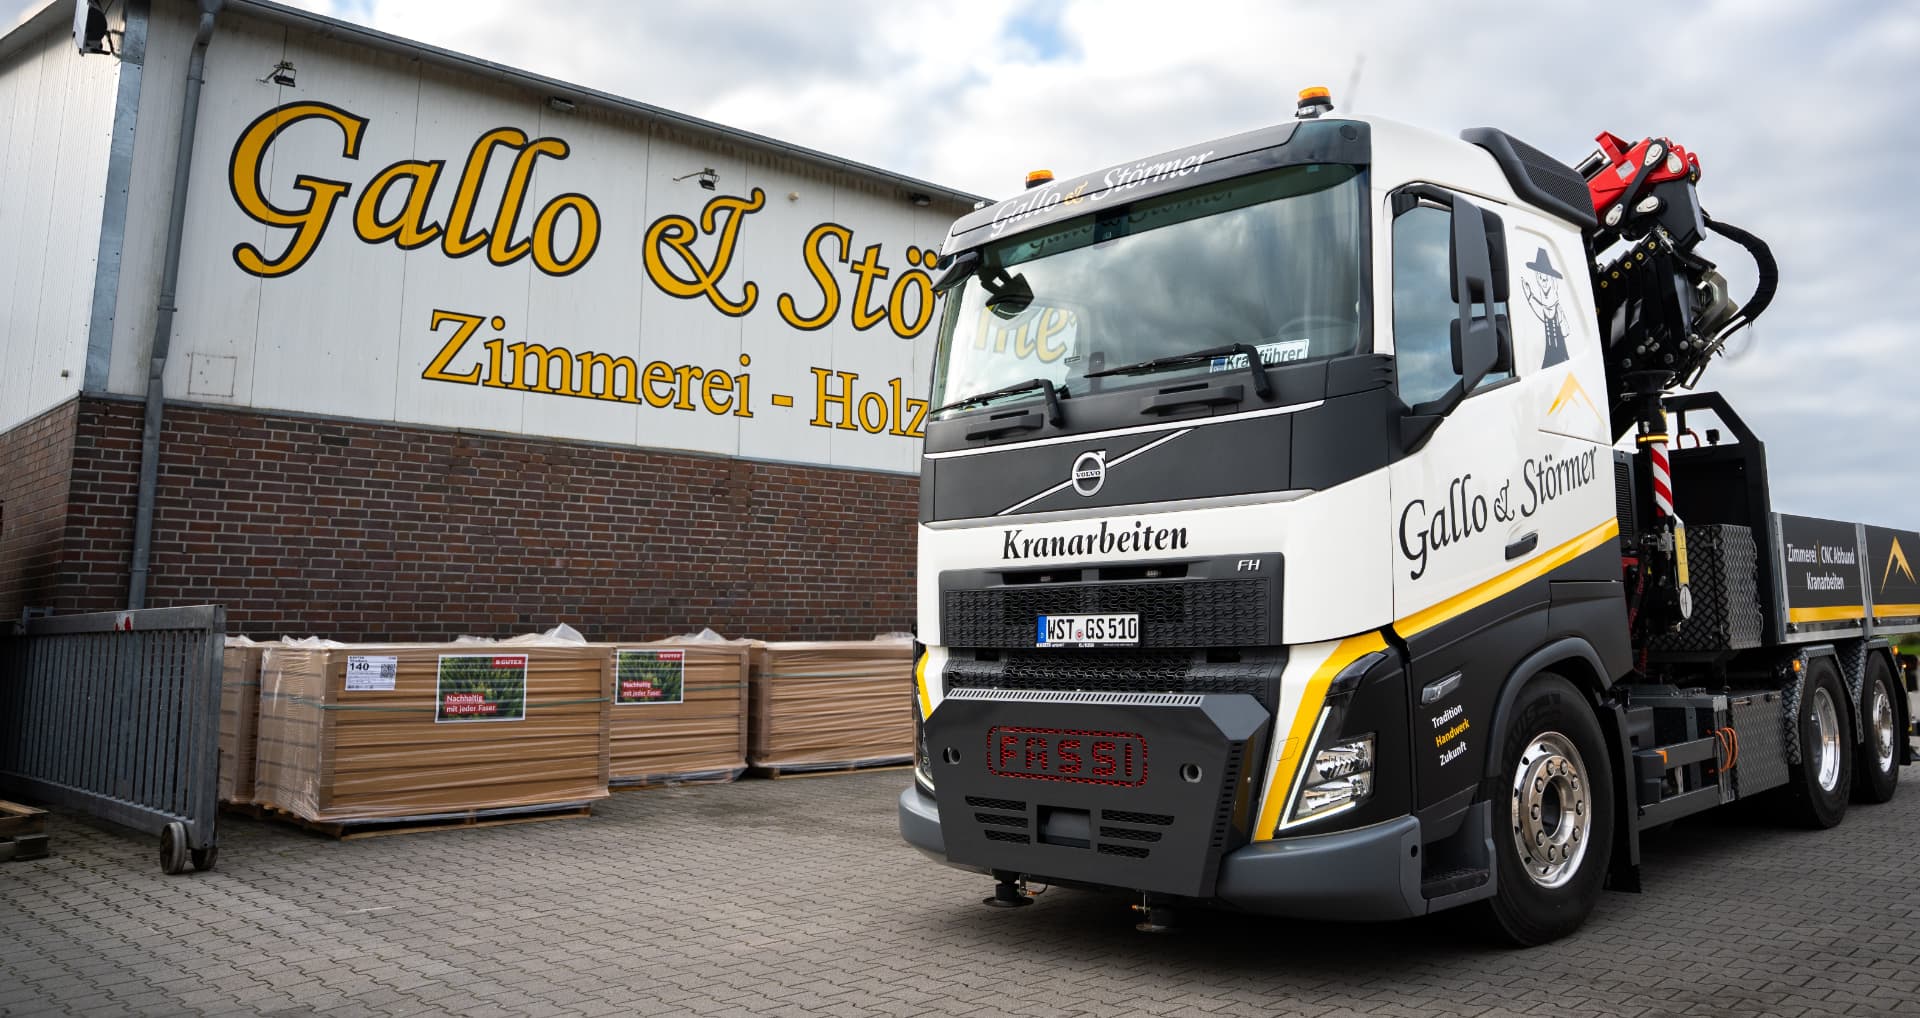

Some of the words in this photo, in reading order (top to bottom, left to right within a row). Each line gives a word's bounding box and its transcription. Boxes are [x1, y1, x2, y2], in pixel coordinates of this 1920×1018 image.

[990, 185, 1062, 239] Gallo
[1063, 180, 1089, 206] &
[1092, 150, 1214, 200] Störmer
[229, 101, 601, 277] Gallo
[643, 188, 766, 317] &
[422, 309, 754, 419] Zimmerei
[1226, 346, 1303, 370] Kraführer
[1076, 470, 1101, 478] VOLVO
[1399, 473, 1488, 580] Gallo
[1493, 478, 1515, 522] &
[1521, 445, 1597, 518] Störmer
[1002, 521, 1189, 560] Kranarbeiten
[1787, 543, 1817, 563] Zimmerei
[1237, 559, 1261, 572] FH
[1807, 571, 1845, 590] Kranarbeiten
[1047, 618, 1074, 640] WST
[1086, 618, 1105, 640] GS
[1108, 618, 1137, 640] 510
[350, 662, 370, 671] 140
[446, 694, 483, 704] Nachhaltig
[446, 705, 458, 713] mit
[459, 704, 476, 714] jeder
[478, 704, 496, 712] Faser
[1432, 704, 1463, 729] Tradition
[1435, 718, 1470, 748] Handwerk
[1000, 736, 1132, 777] FASSI
[1440, 740, 1467, 766] Zukunft
